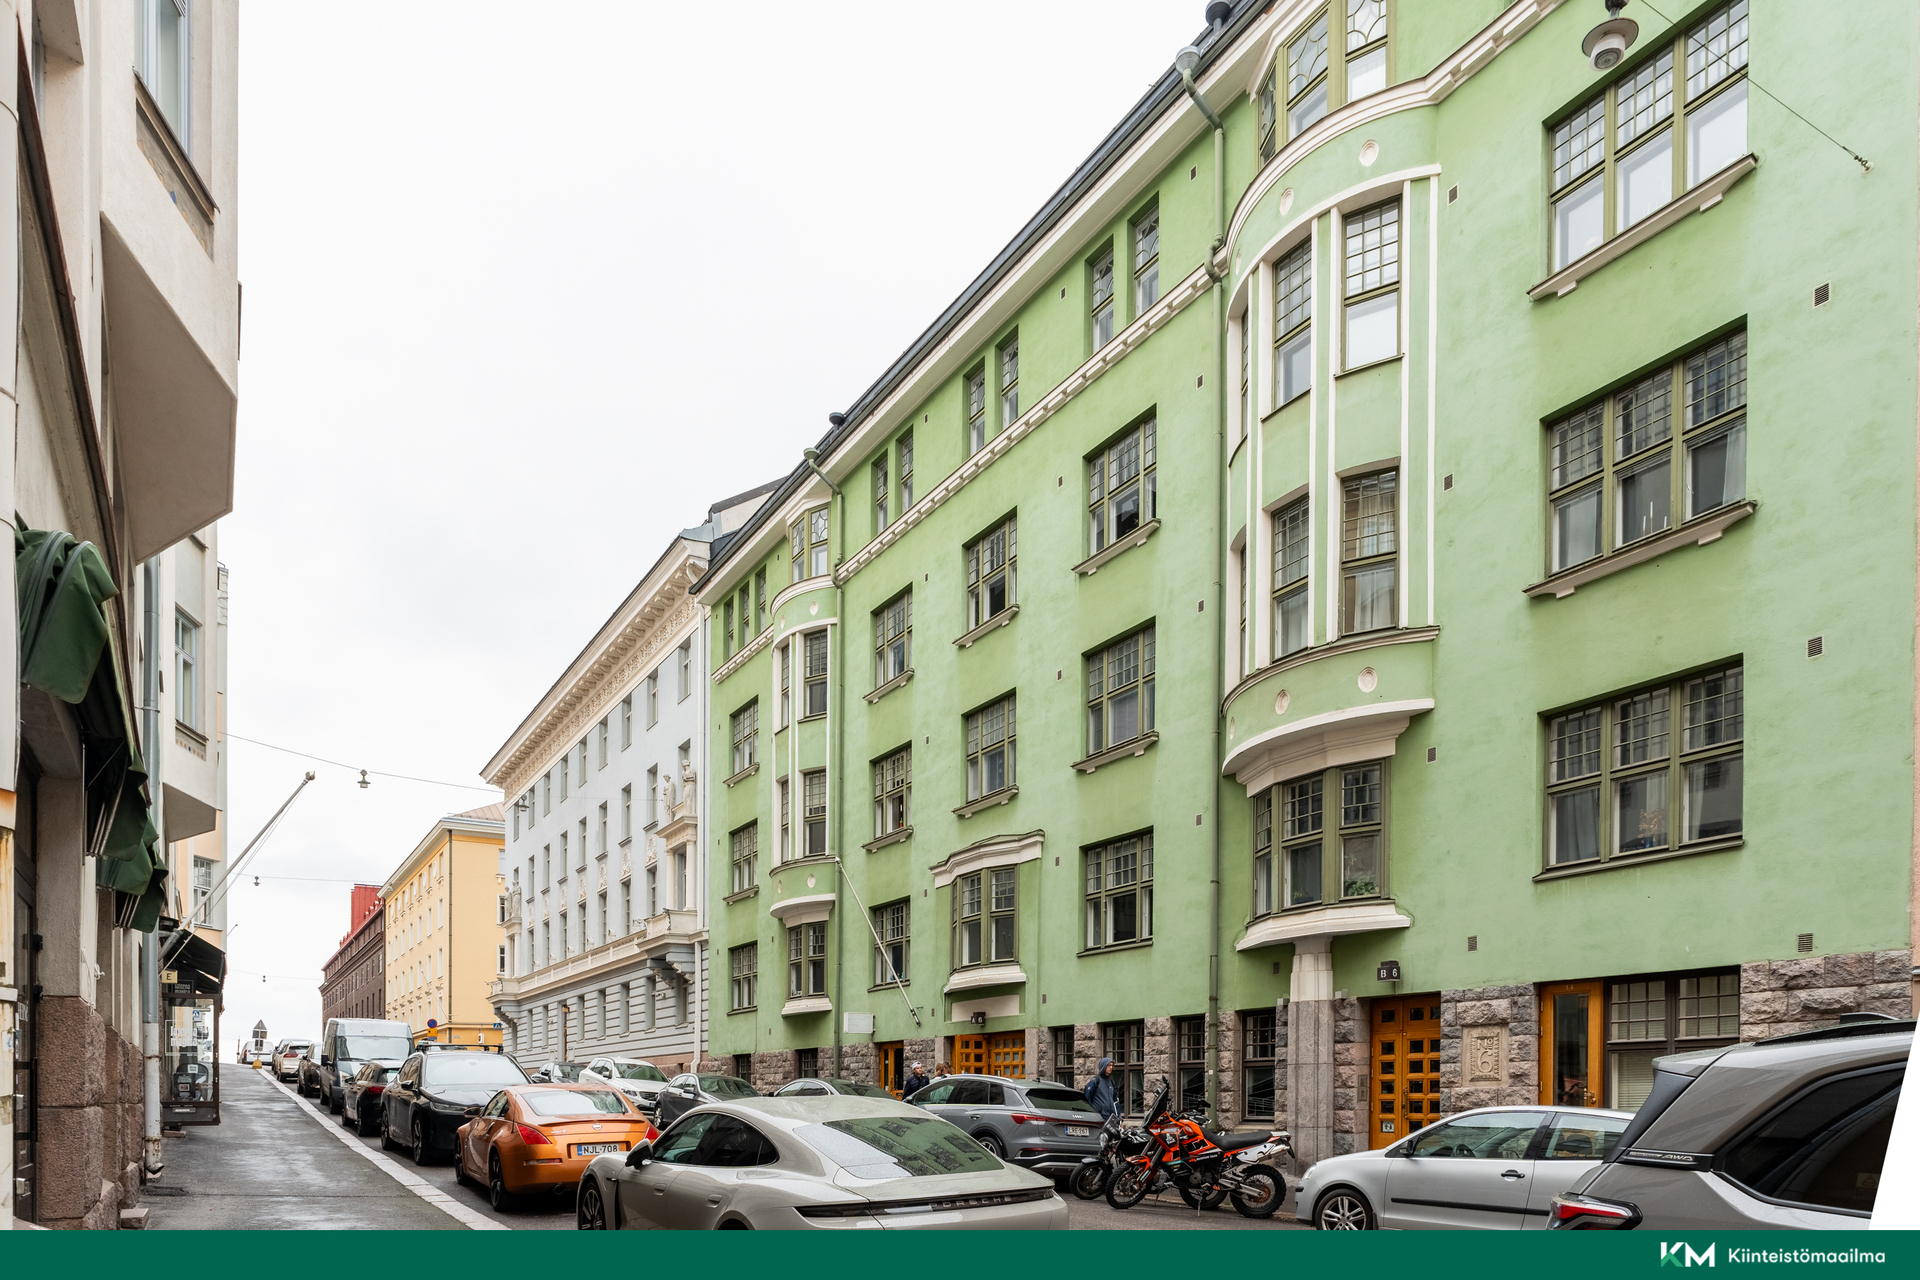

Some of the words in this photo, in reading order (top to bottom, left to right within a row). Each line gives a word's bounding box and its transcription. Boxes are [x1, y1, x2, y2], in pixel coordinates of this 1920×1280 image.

[1380, 969, 1387, 978] B
[1392, 968, 1398, 977] 6
[1477, 1050, 1493, 1073] 6
[583, 1144, 618, 1154] NJL-708
[1661, 1154, 1693, 1162] AWD
[928, 1195, 1012, 1208] PORSCHE
